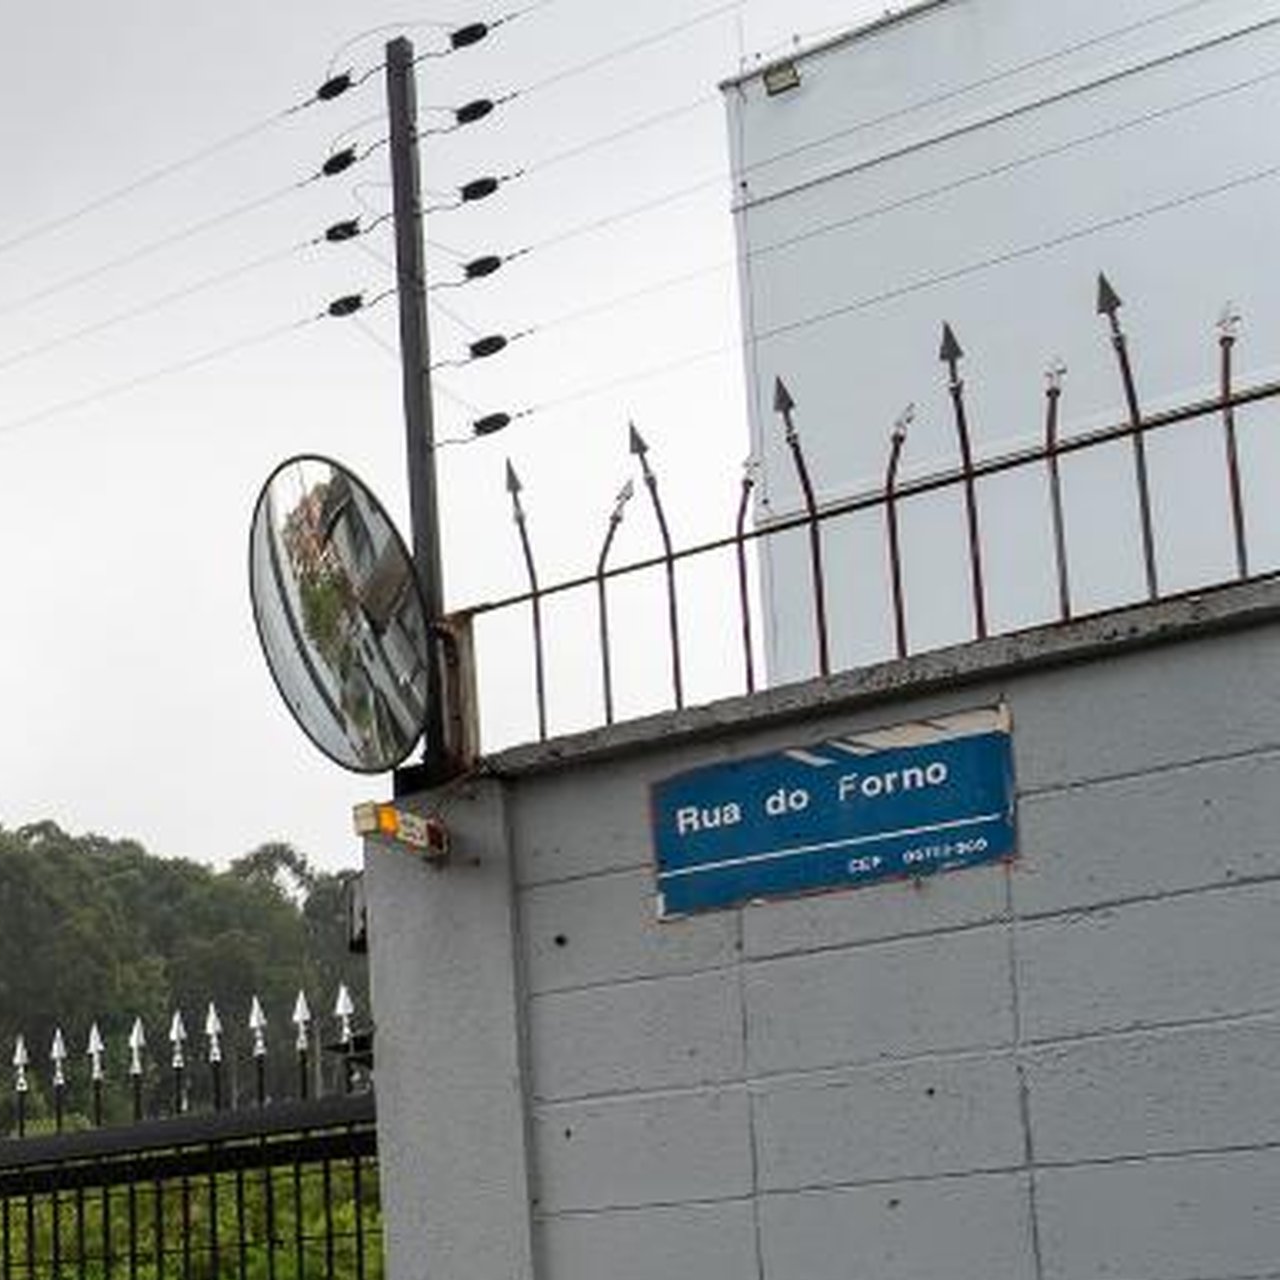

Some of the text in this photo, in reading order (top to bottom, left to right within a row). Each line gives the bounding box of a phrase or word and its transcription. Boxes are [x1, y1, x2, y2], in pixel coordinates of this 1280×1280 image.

[676, 760, 948, 836] Rua do Forno
